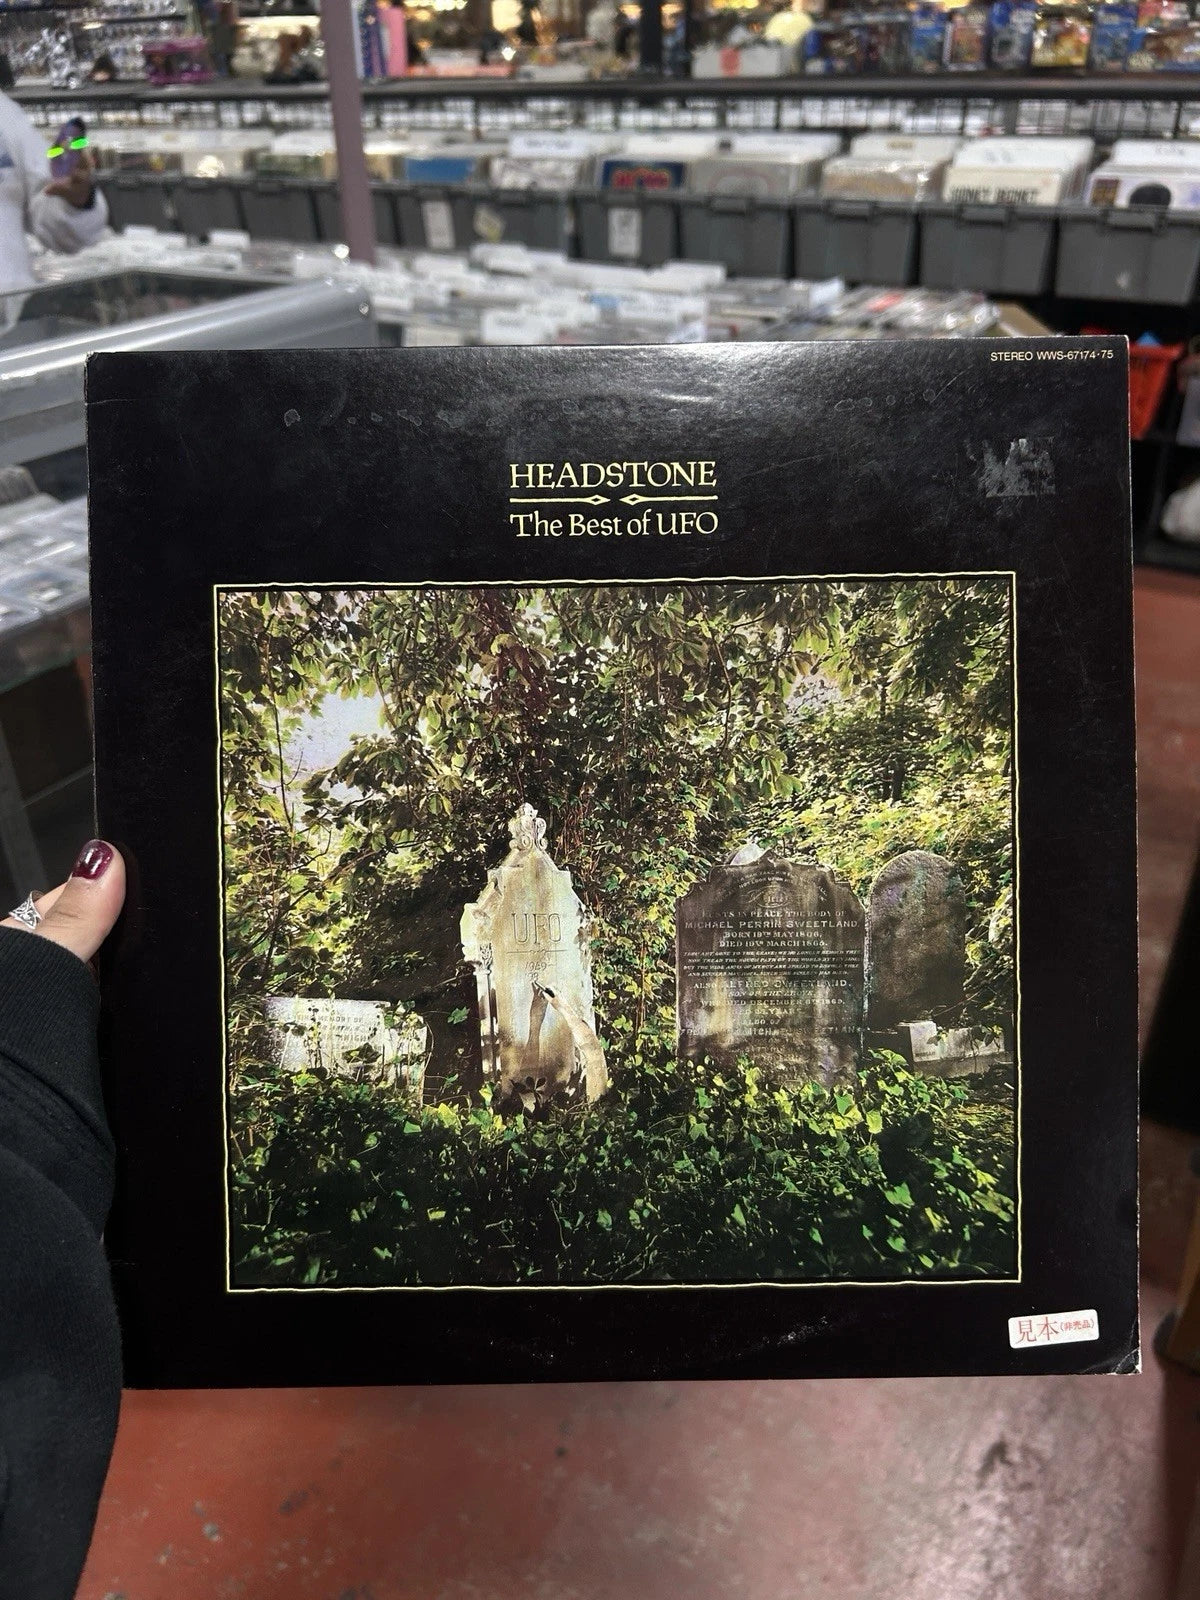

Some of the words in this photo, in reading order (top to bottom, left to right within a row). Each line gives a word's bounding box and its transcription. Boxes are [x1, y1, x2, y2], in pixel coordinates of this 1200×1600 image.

[990, 351, 1033, 361] STEREO
[509, 461, 718, 489] HEADSTONE
[509, 510, 563, 537] The
[568, 513, 622, 536] Best
[627, 508, 652, 536] of
[656, 511, 719, 535] UFO
[750, 909, 783, 918] PEACE
[511, 912, 561, 945] UFO
[685, 921, 734, 929] MICHAEL
